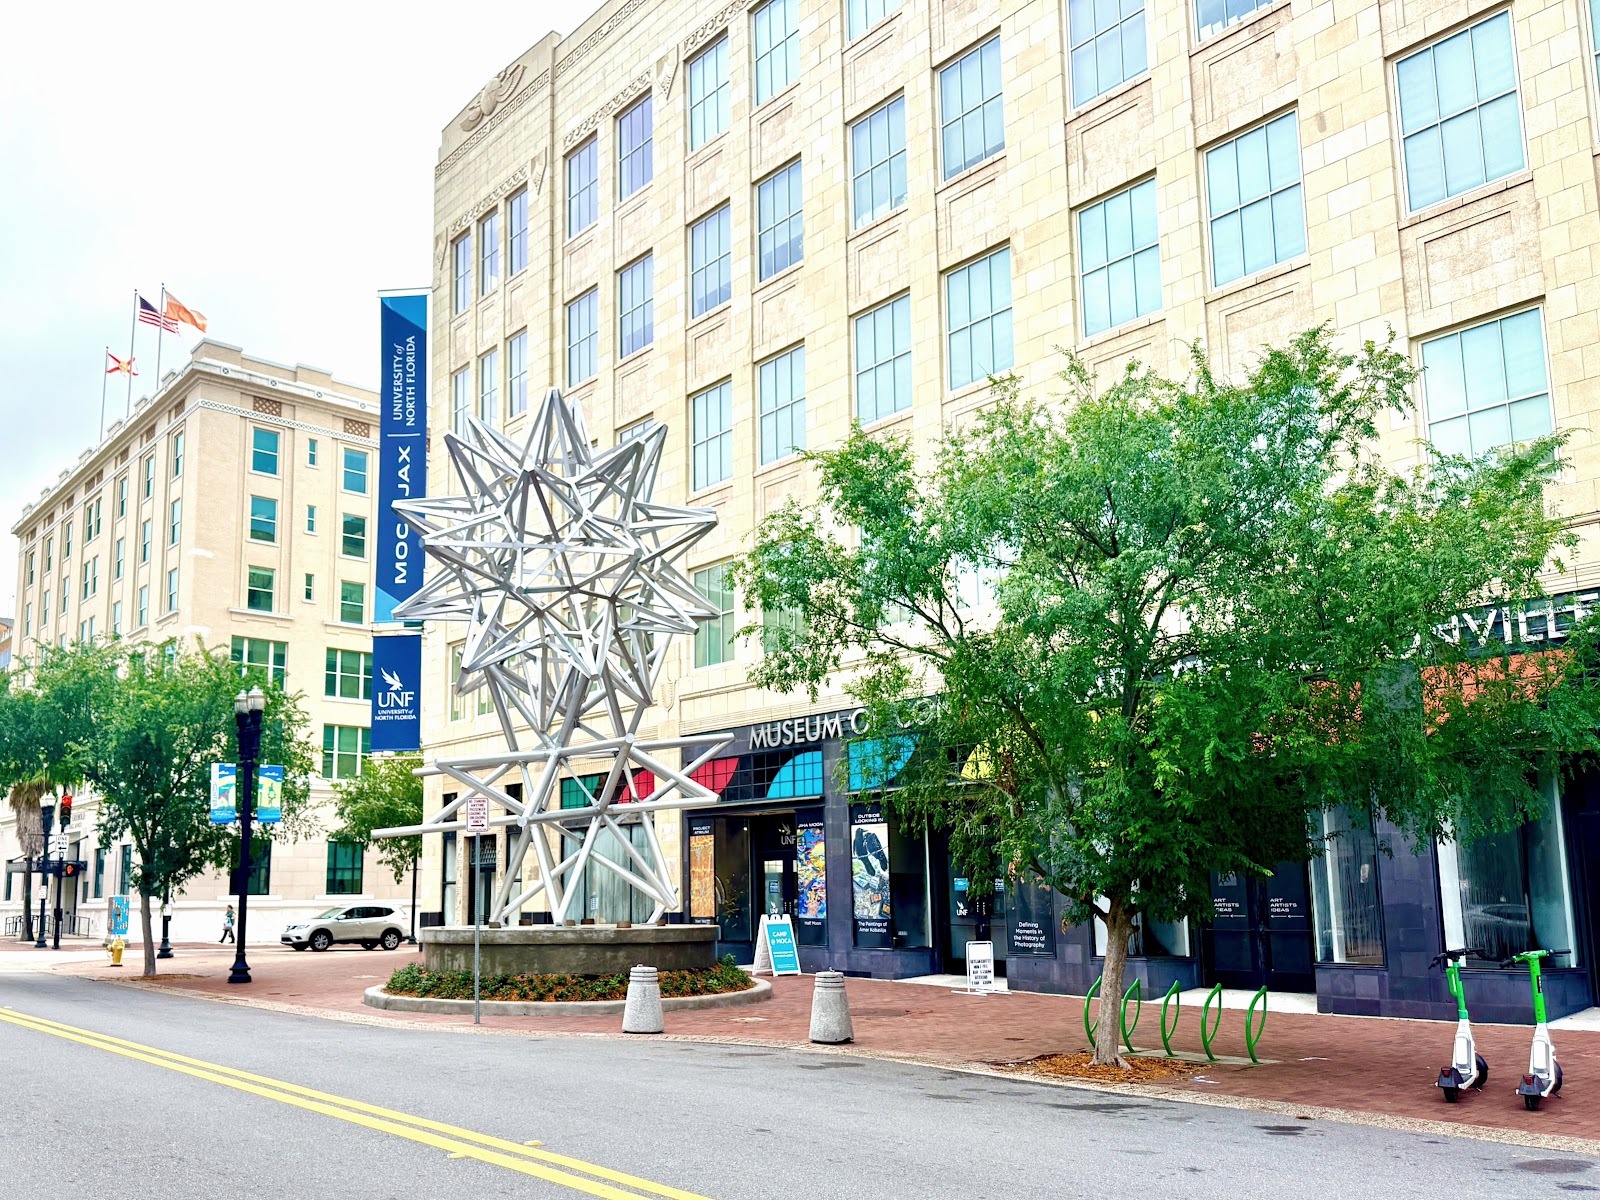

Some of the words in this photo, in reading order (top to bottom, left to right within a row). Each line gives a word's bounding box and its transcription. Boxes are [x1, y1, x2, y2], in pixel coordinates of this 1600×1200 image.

[393, 343, 405, 355] of
[405, 335, 415, 383] FLORIDA
[393, 355, 403, 421] UNIVERSITY
[405, 386, 415, 427] NORTH
[397, 445, 411, 497] JAX
[394, 512, 409, 585] MOC
[377, 691, 415, 708] UNF
[749, 713, 844, 750] MUSEUM
[780, 835, 797, 846] UNF
[1018, 921, 1039, 929] Defining
[776, 937, 793, 945] MOCA
[1014, 941, 1046, 949] Photography
